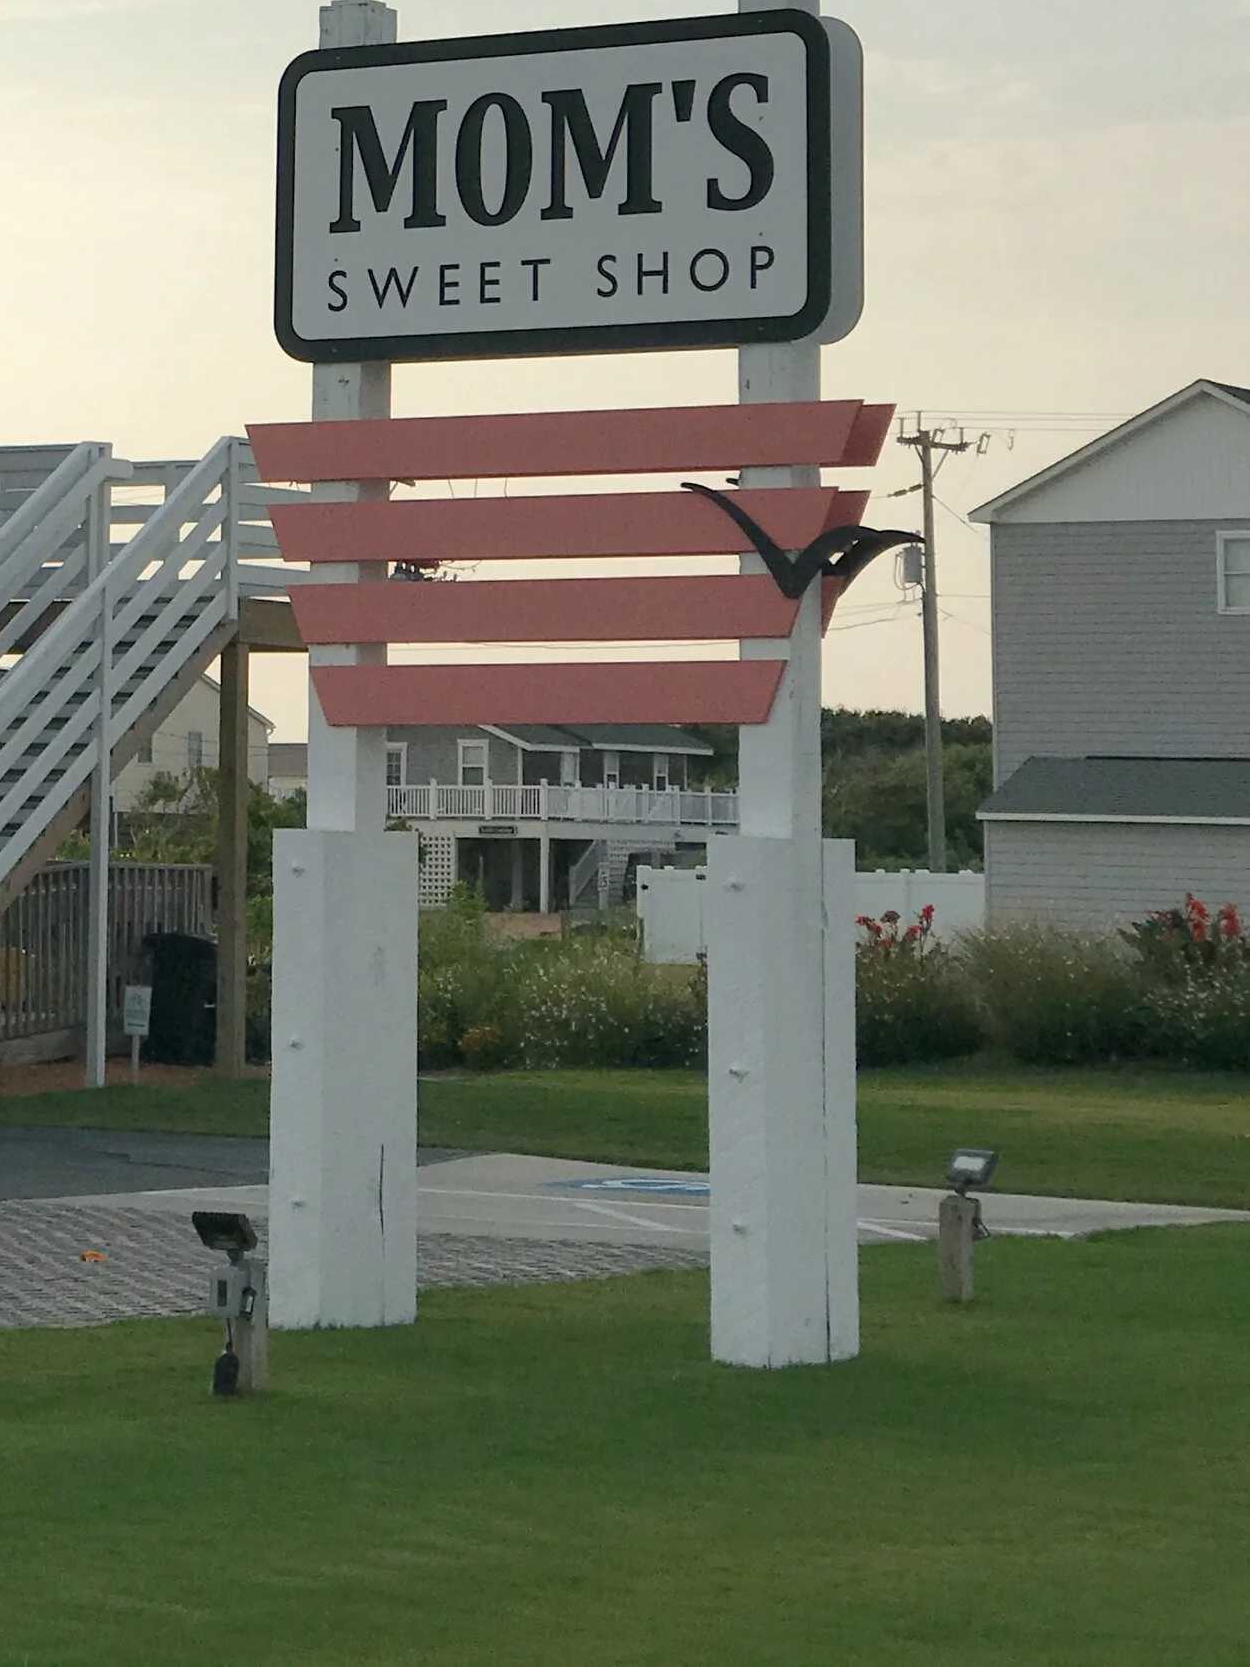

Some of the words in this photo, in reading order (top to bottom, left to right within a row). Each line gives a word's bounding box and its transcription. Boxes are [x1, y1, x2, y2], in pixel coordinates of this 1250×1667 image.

[328, 73, 775, 234] MOM'S
[327, 259, 551, 312] SWEET
[597, 246, 775, 297] SHOP
